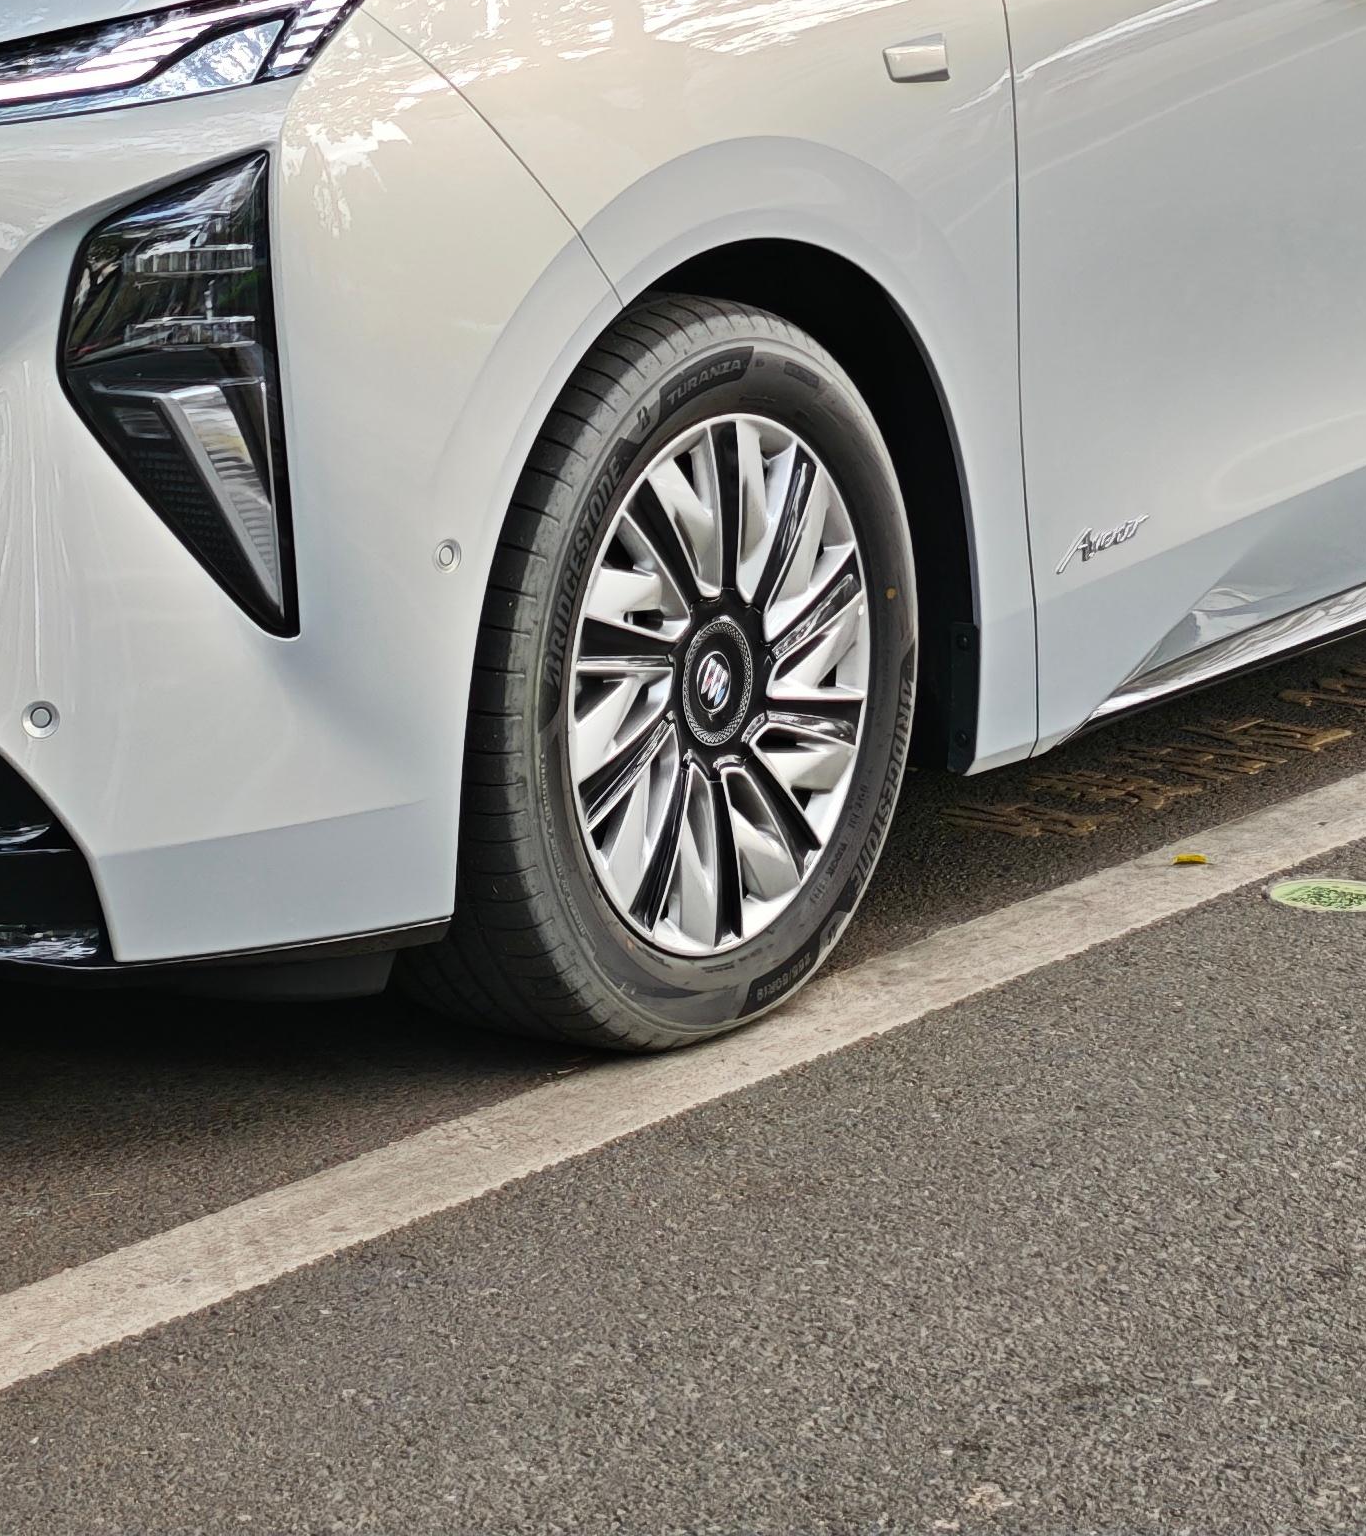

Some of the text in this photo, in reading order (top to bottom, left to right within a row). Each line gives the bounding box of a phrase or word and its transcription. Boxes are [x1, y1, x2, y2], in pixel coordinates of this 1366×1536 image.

[665, 358, 742, 406] TURANZA
[543, 455, 624, 693] BRIDGESTONE
[848, 678, 914, 898] BRIDGESTONE
